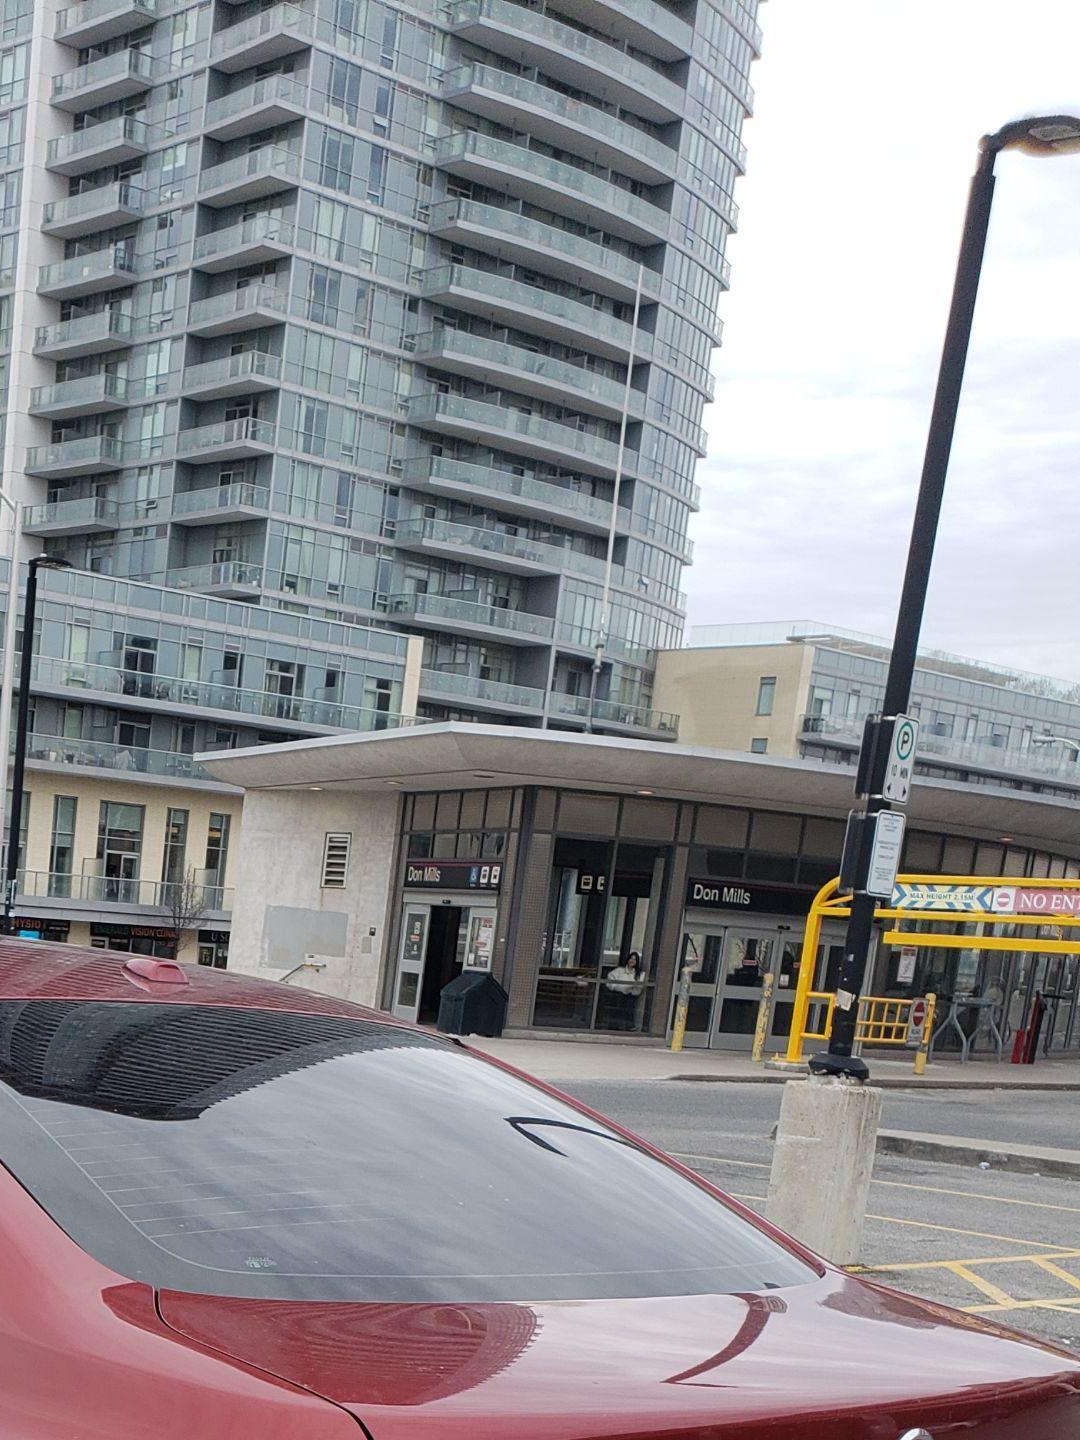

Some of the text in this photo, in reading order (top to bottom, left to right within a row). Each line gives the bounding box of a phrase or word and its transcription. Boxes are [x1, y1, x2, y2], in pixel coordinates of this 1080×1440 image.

[407, 866, 441, 883] Don Mills
[693, 884, 751, 905] Don Mills
[926, 892, 952, 900] HEIGHT
[1020, 893, 1047, 909] NO
[10, 917, 41, 930] HYSIO
[130, 926, 155, 938] VISION
